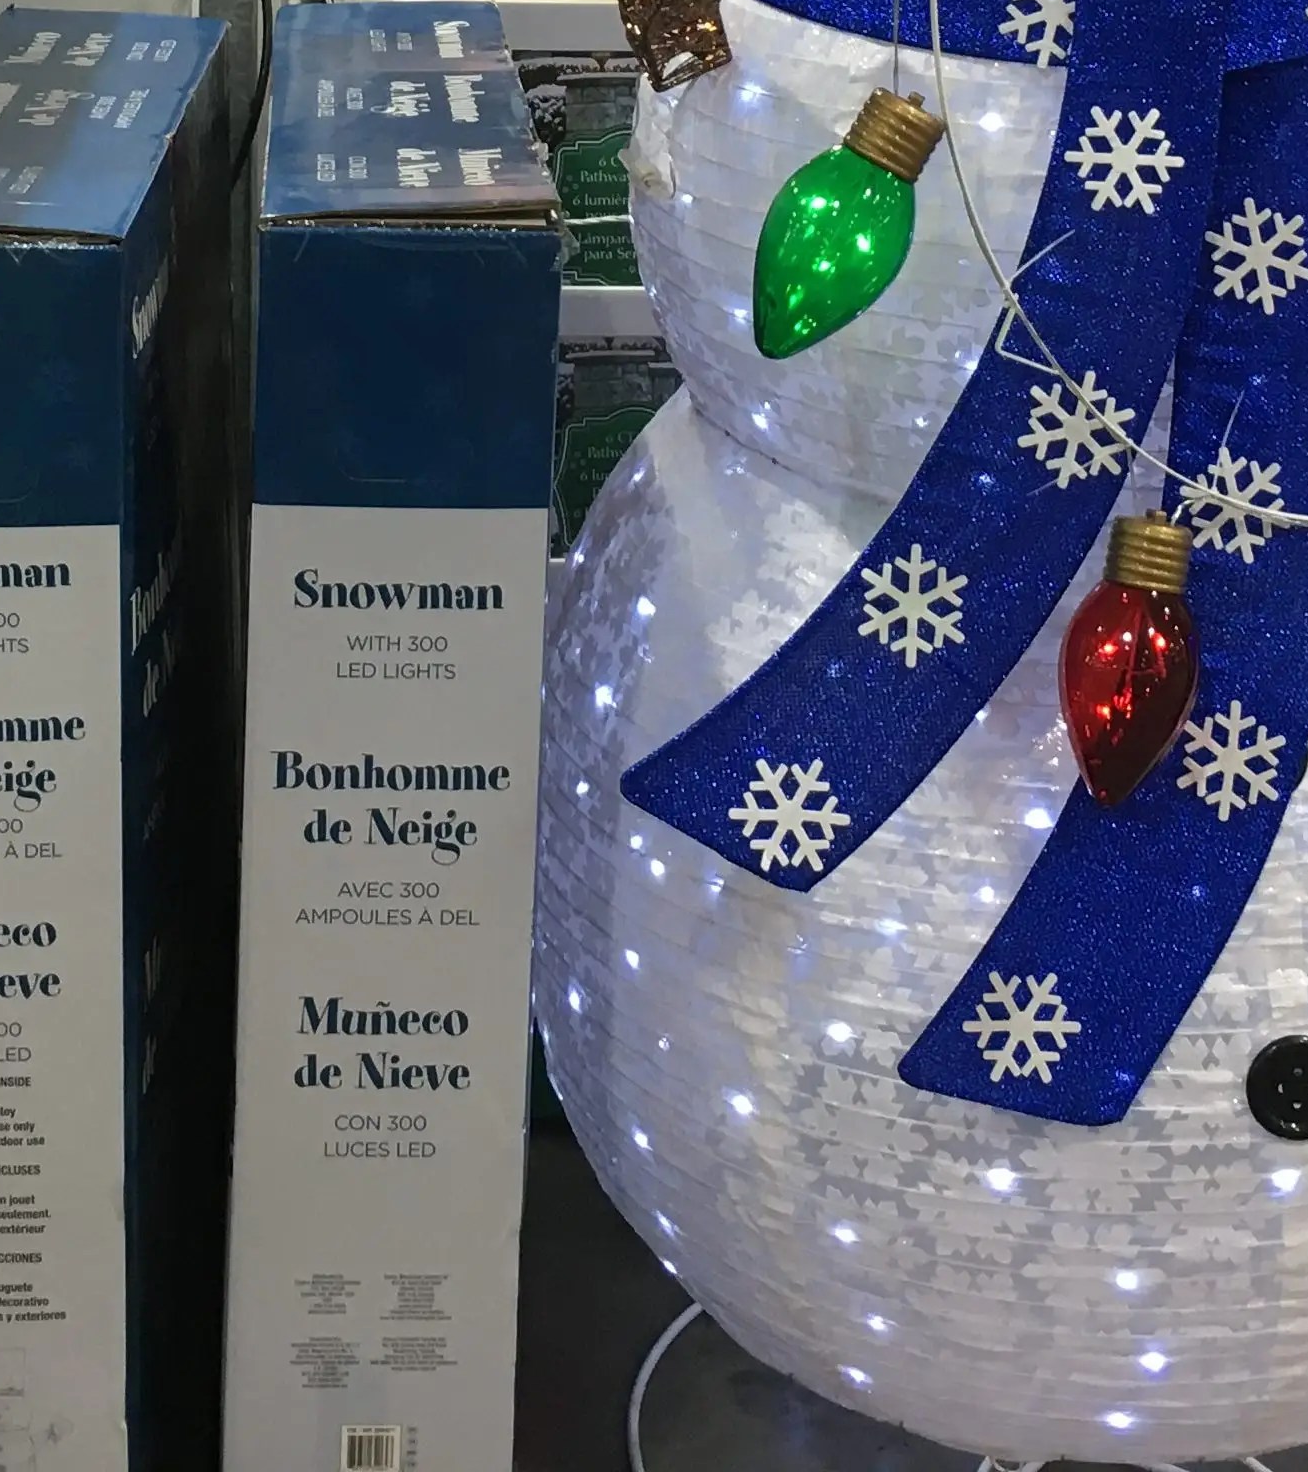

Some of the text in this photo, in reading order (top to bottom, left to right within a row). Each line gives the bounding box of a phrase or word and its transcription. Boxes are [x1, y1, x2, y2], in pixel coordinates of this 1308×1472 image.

[295, 569, 503, 610] Snowman
[347, 636, 447, 652] WITH 300
[337, 662, 455, 679] LED LIGHTS
[272, 751, 510, 791] Bonhomme
[304, 808, 477, 865] de Neige
[4, 841, 18, 858] À
[25, 843, 61, 858] DEL
[338, 882, 439, 898] AVEC 300
[296, 906, 479, 925] AMPOULES À DEL
[299, 997, 468, 1036] Muñeco
[295, 1052, 470, 1090] de Nieve
[0, 1106, 16, 1118] toy
[13, 1121, 35, 1133] only
[335, 1115, 426, 1131] CON 300
[26, 1137, 45, 1146] use
[324, 1142, 436, 1157] LUCES LED
